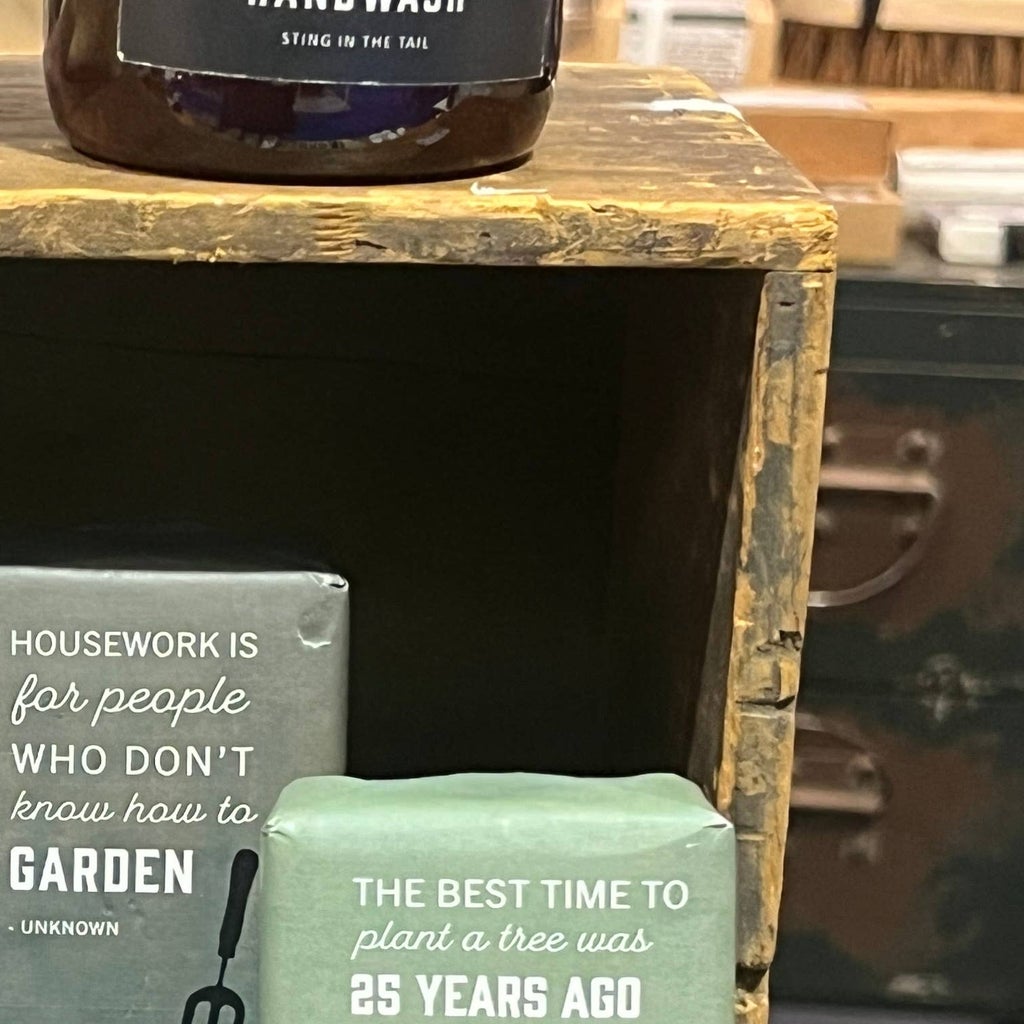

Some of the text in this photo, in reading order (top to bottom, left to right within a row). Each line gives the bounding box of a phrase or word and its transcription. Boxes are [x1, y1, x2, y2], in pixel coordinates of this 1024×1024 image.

[281, 31, 428, 50] STING IN THE TAIL
[11, 629, 258, 659] HOUSEWORK IS
[10, 672, 251, 728] for people
[11, 743, 255, 777] WHO DON'T
[10, 790, 259, 825] know how to
[10, 846, 194, 894] GARDEN
[351, 877, 690, 911] THE BEST TIME TO
[21, 919, 119, 936] UNKNOWN
[350, 920, 654, 961] plant a tree was
[350, 973, 641, 1019] 25 YEARS AGO
